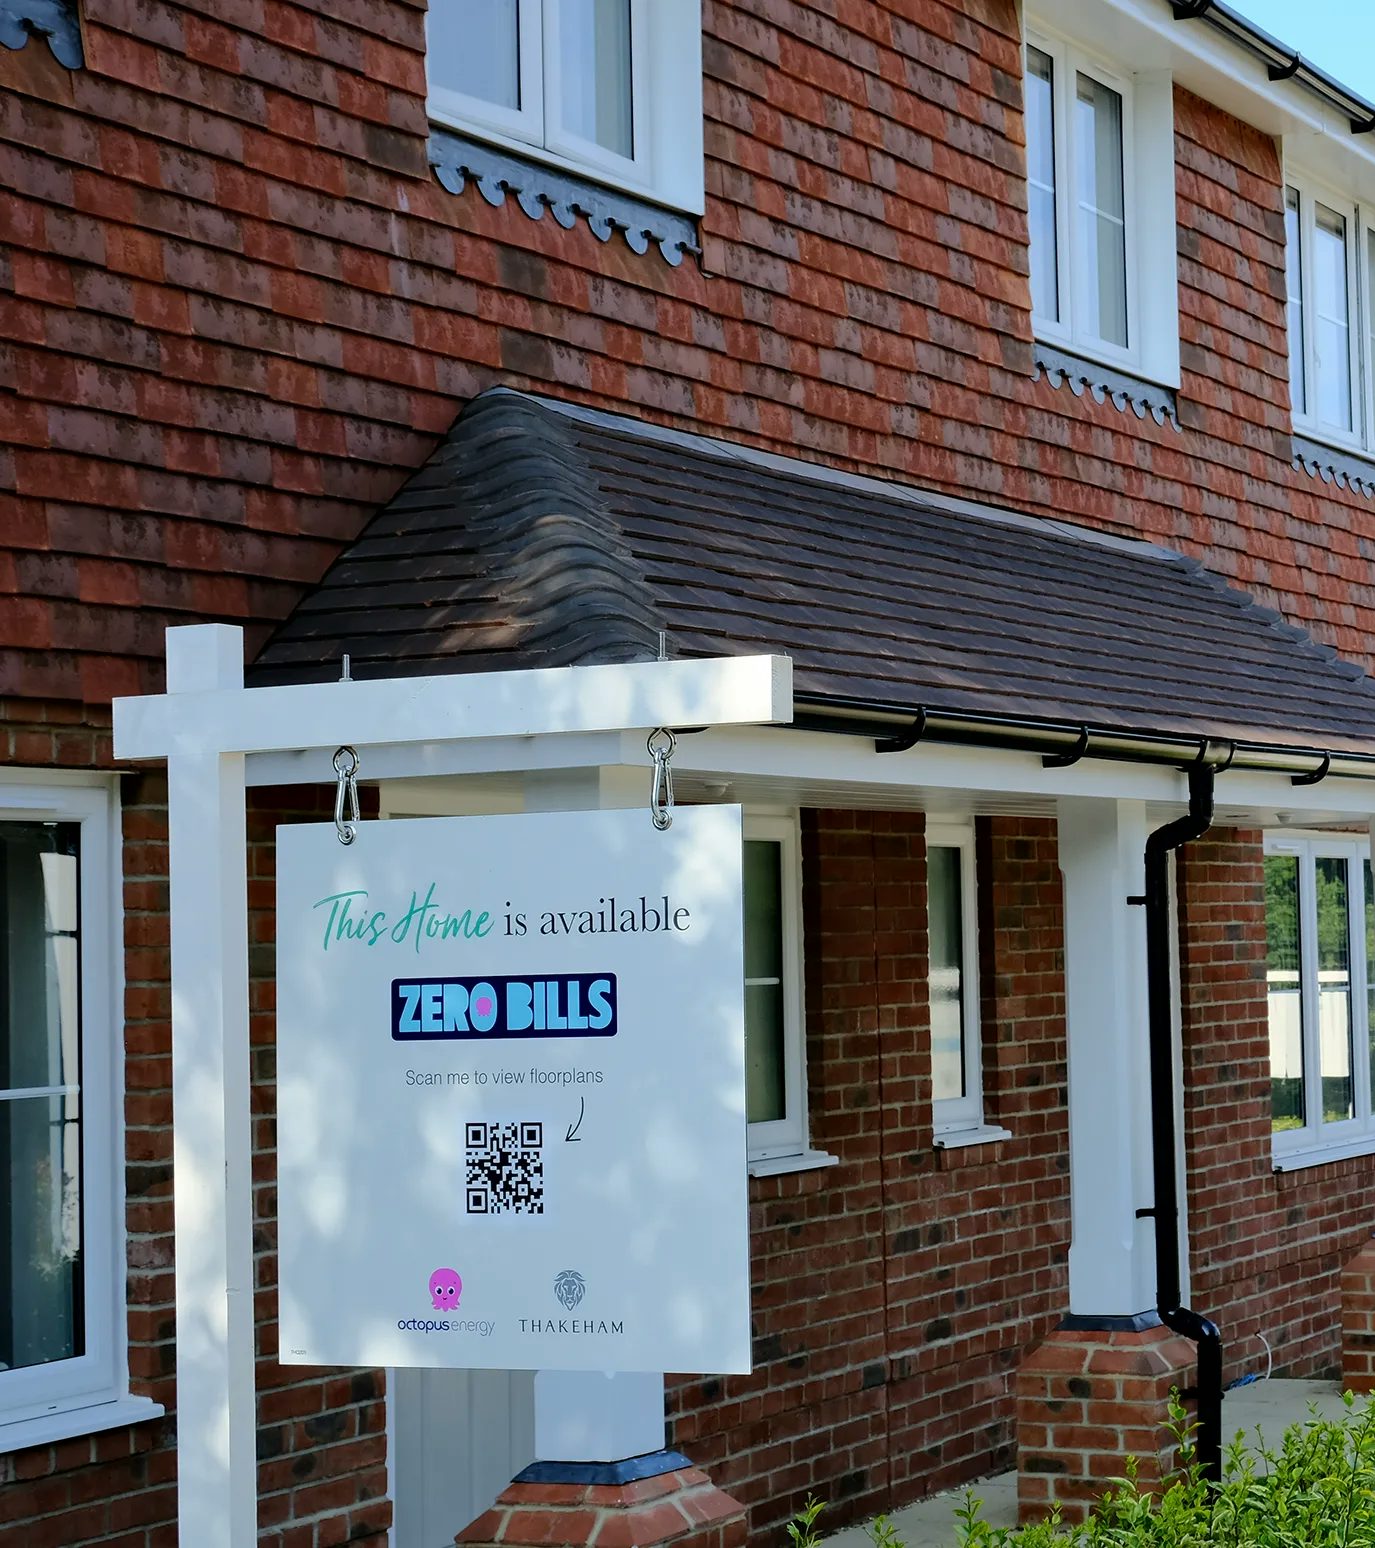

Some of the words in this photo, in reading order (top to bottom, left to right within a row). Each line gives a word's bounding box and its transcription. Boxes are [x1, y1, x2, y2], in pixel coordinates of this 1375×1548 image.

[313, 890, 388, 951] This
[391, 882, 495, 954] Home
[503, 901, 528, 937] is
[540, 895, 691, 935] available
[399, 982, 497, 1033] ZERO
[506, 979, 613, 1031] BILLS
[405, 1069, 443, 1086] Scan
[447, 1071, 470, 1085] me
[474, 1071, 488, 1085] to
[492, 1069, 526, 1084] view
[529, 1067, 604, 1087] floorplans
[518, 1319, 624, 1334] THAKEHAM
